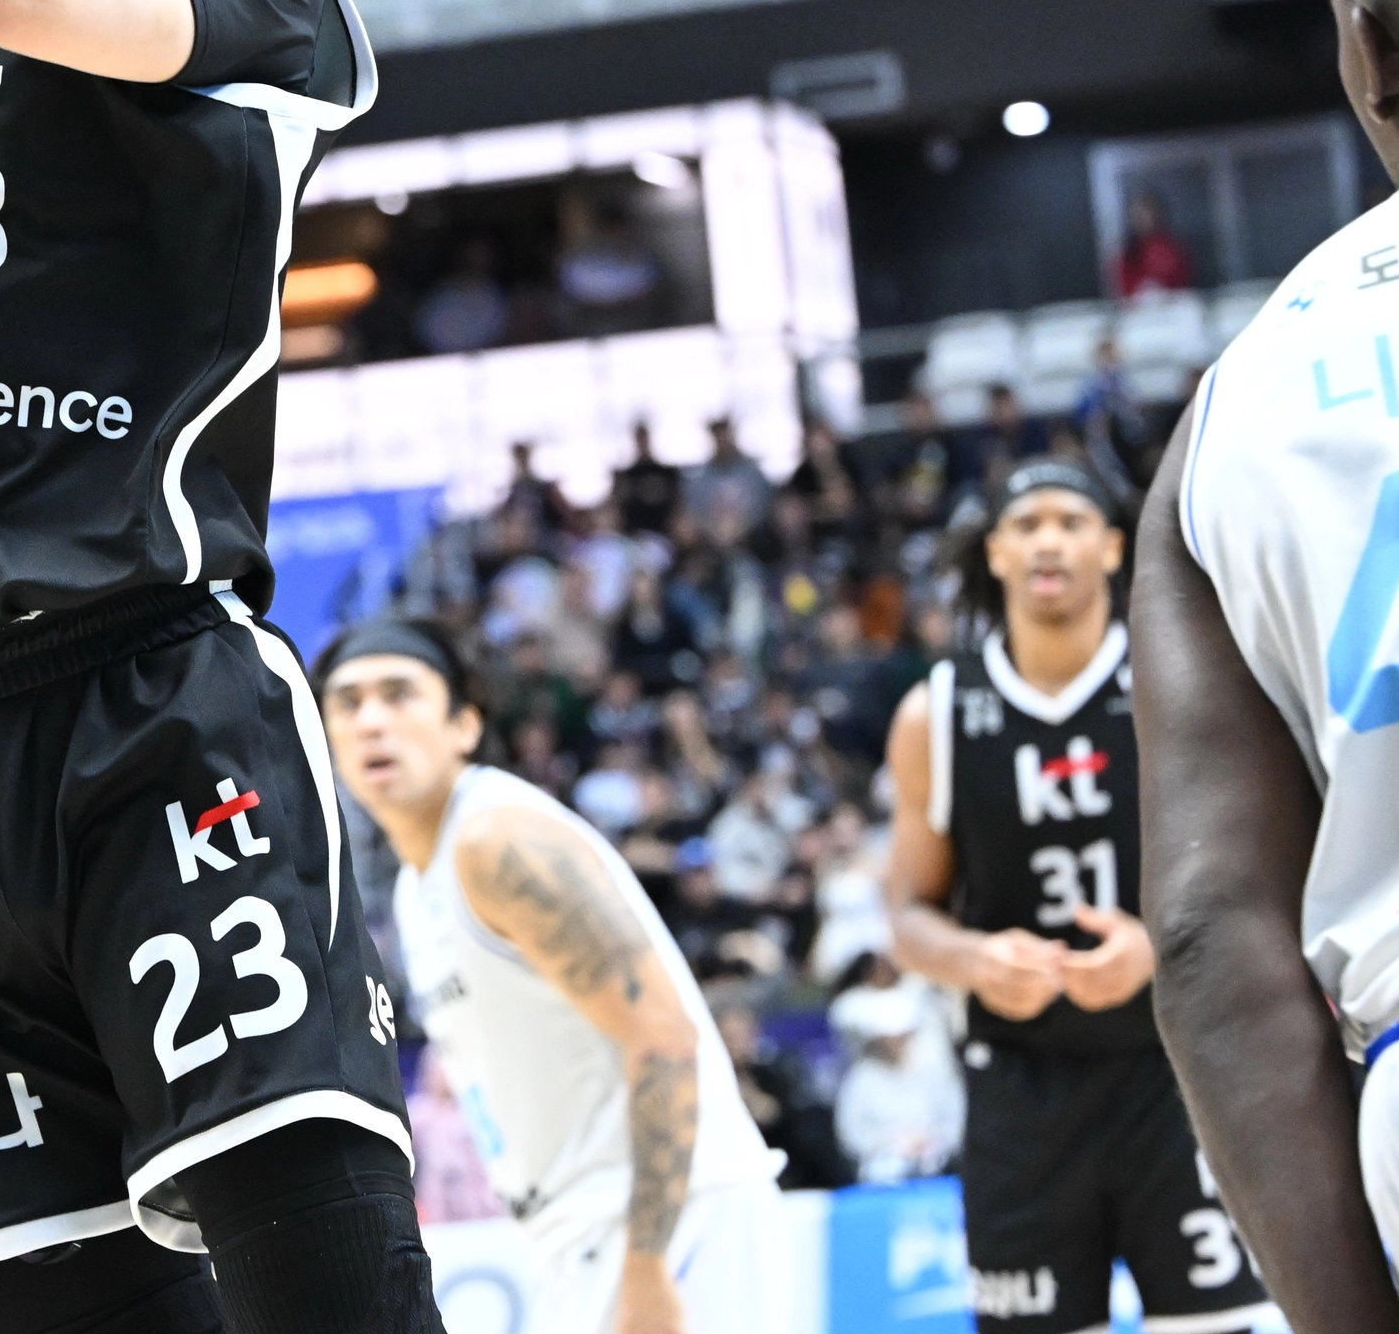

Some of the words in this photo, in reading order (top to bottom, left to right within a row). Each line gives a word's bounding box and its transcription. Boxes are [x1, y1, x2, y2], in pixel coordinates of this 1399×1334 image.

[1014, 735, 1112, 826] kt
[165, 777, 271, 884] kt
[1029, 838, 1120, 928] 31
[129, 895, 308, 1084] 23
[1180, 1208, 1262, 1289] 3
